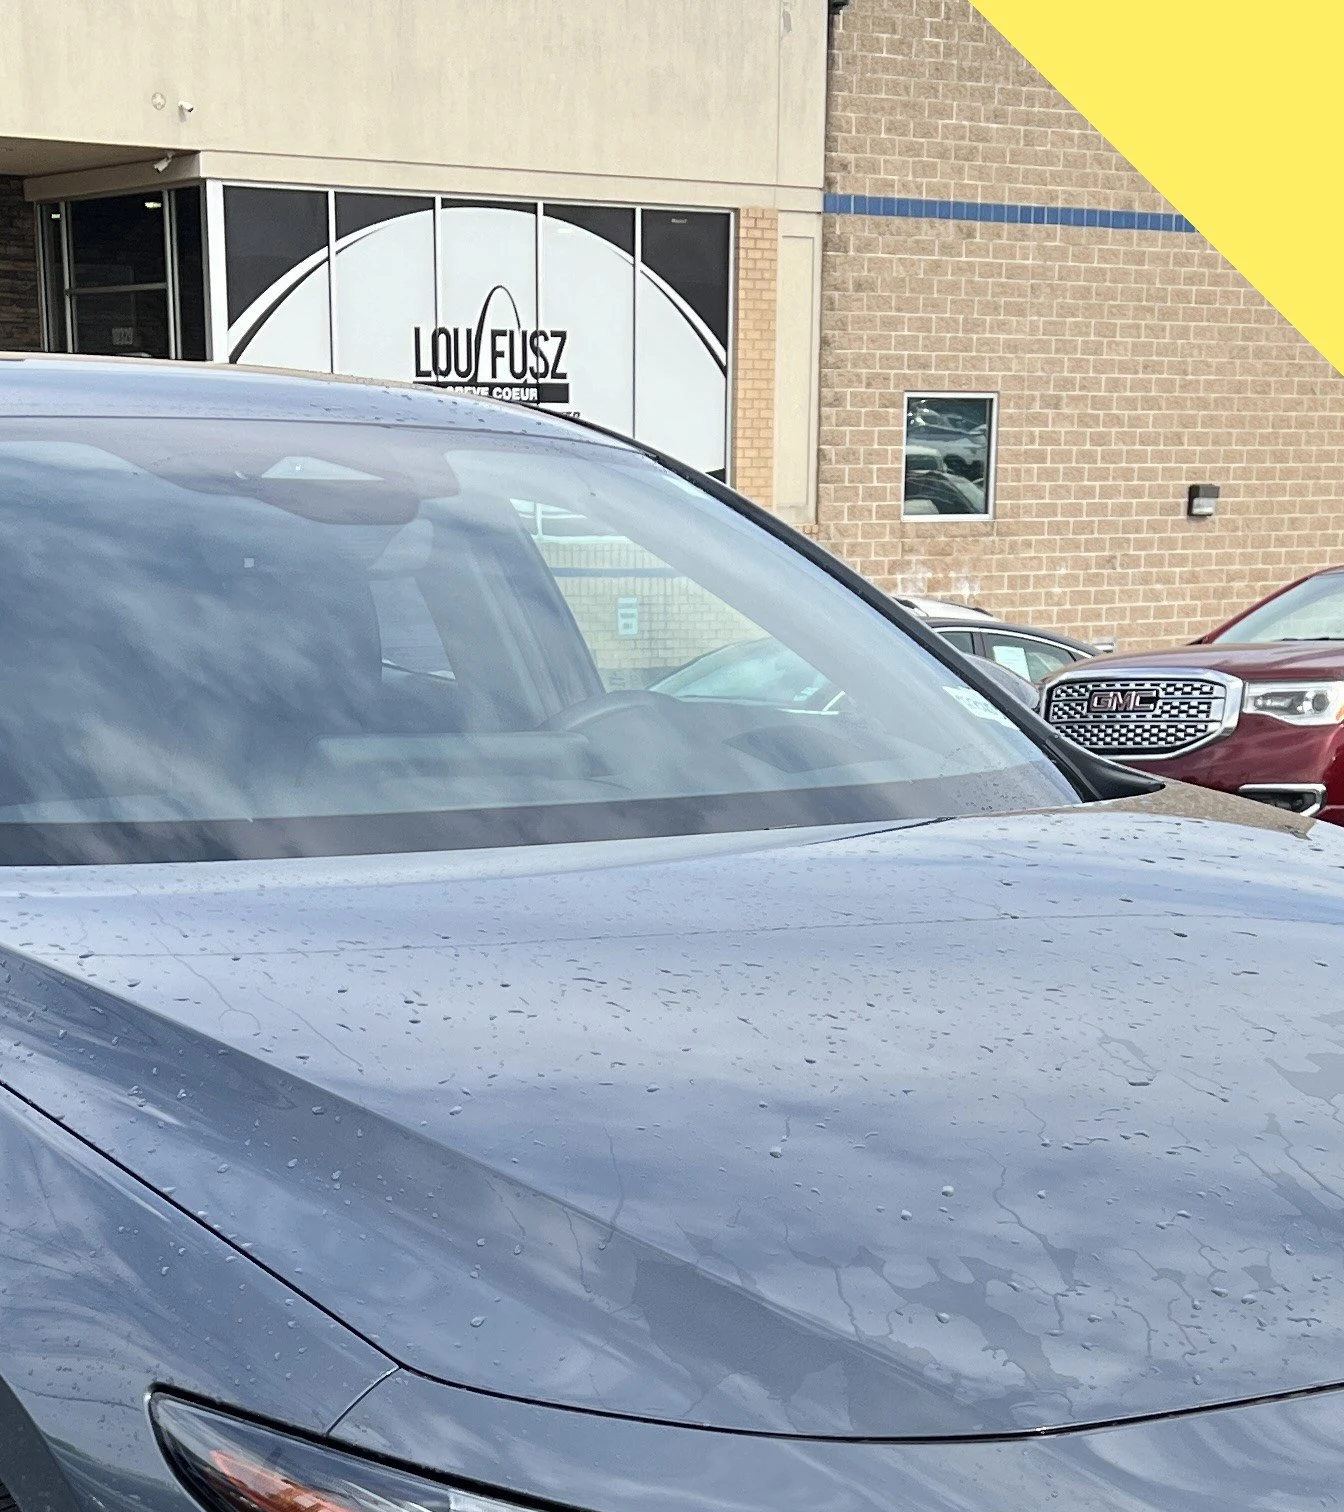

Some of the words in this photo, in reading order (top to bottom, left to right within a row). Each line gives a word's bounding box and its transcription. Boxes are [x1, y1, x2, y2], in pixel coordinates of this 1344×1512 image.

[413, 326, 474, 379] LOU
[490, 328, 568, 380] FUSZ
[492, 387, 538, 401] COEUR
[1090, 690, 1157, 712] GMC
